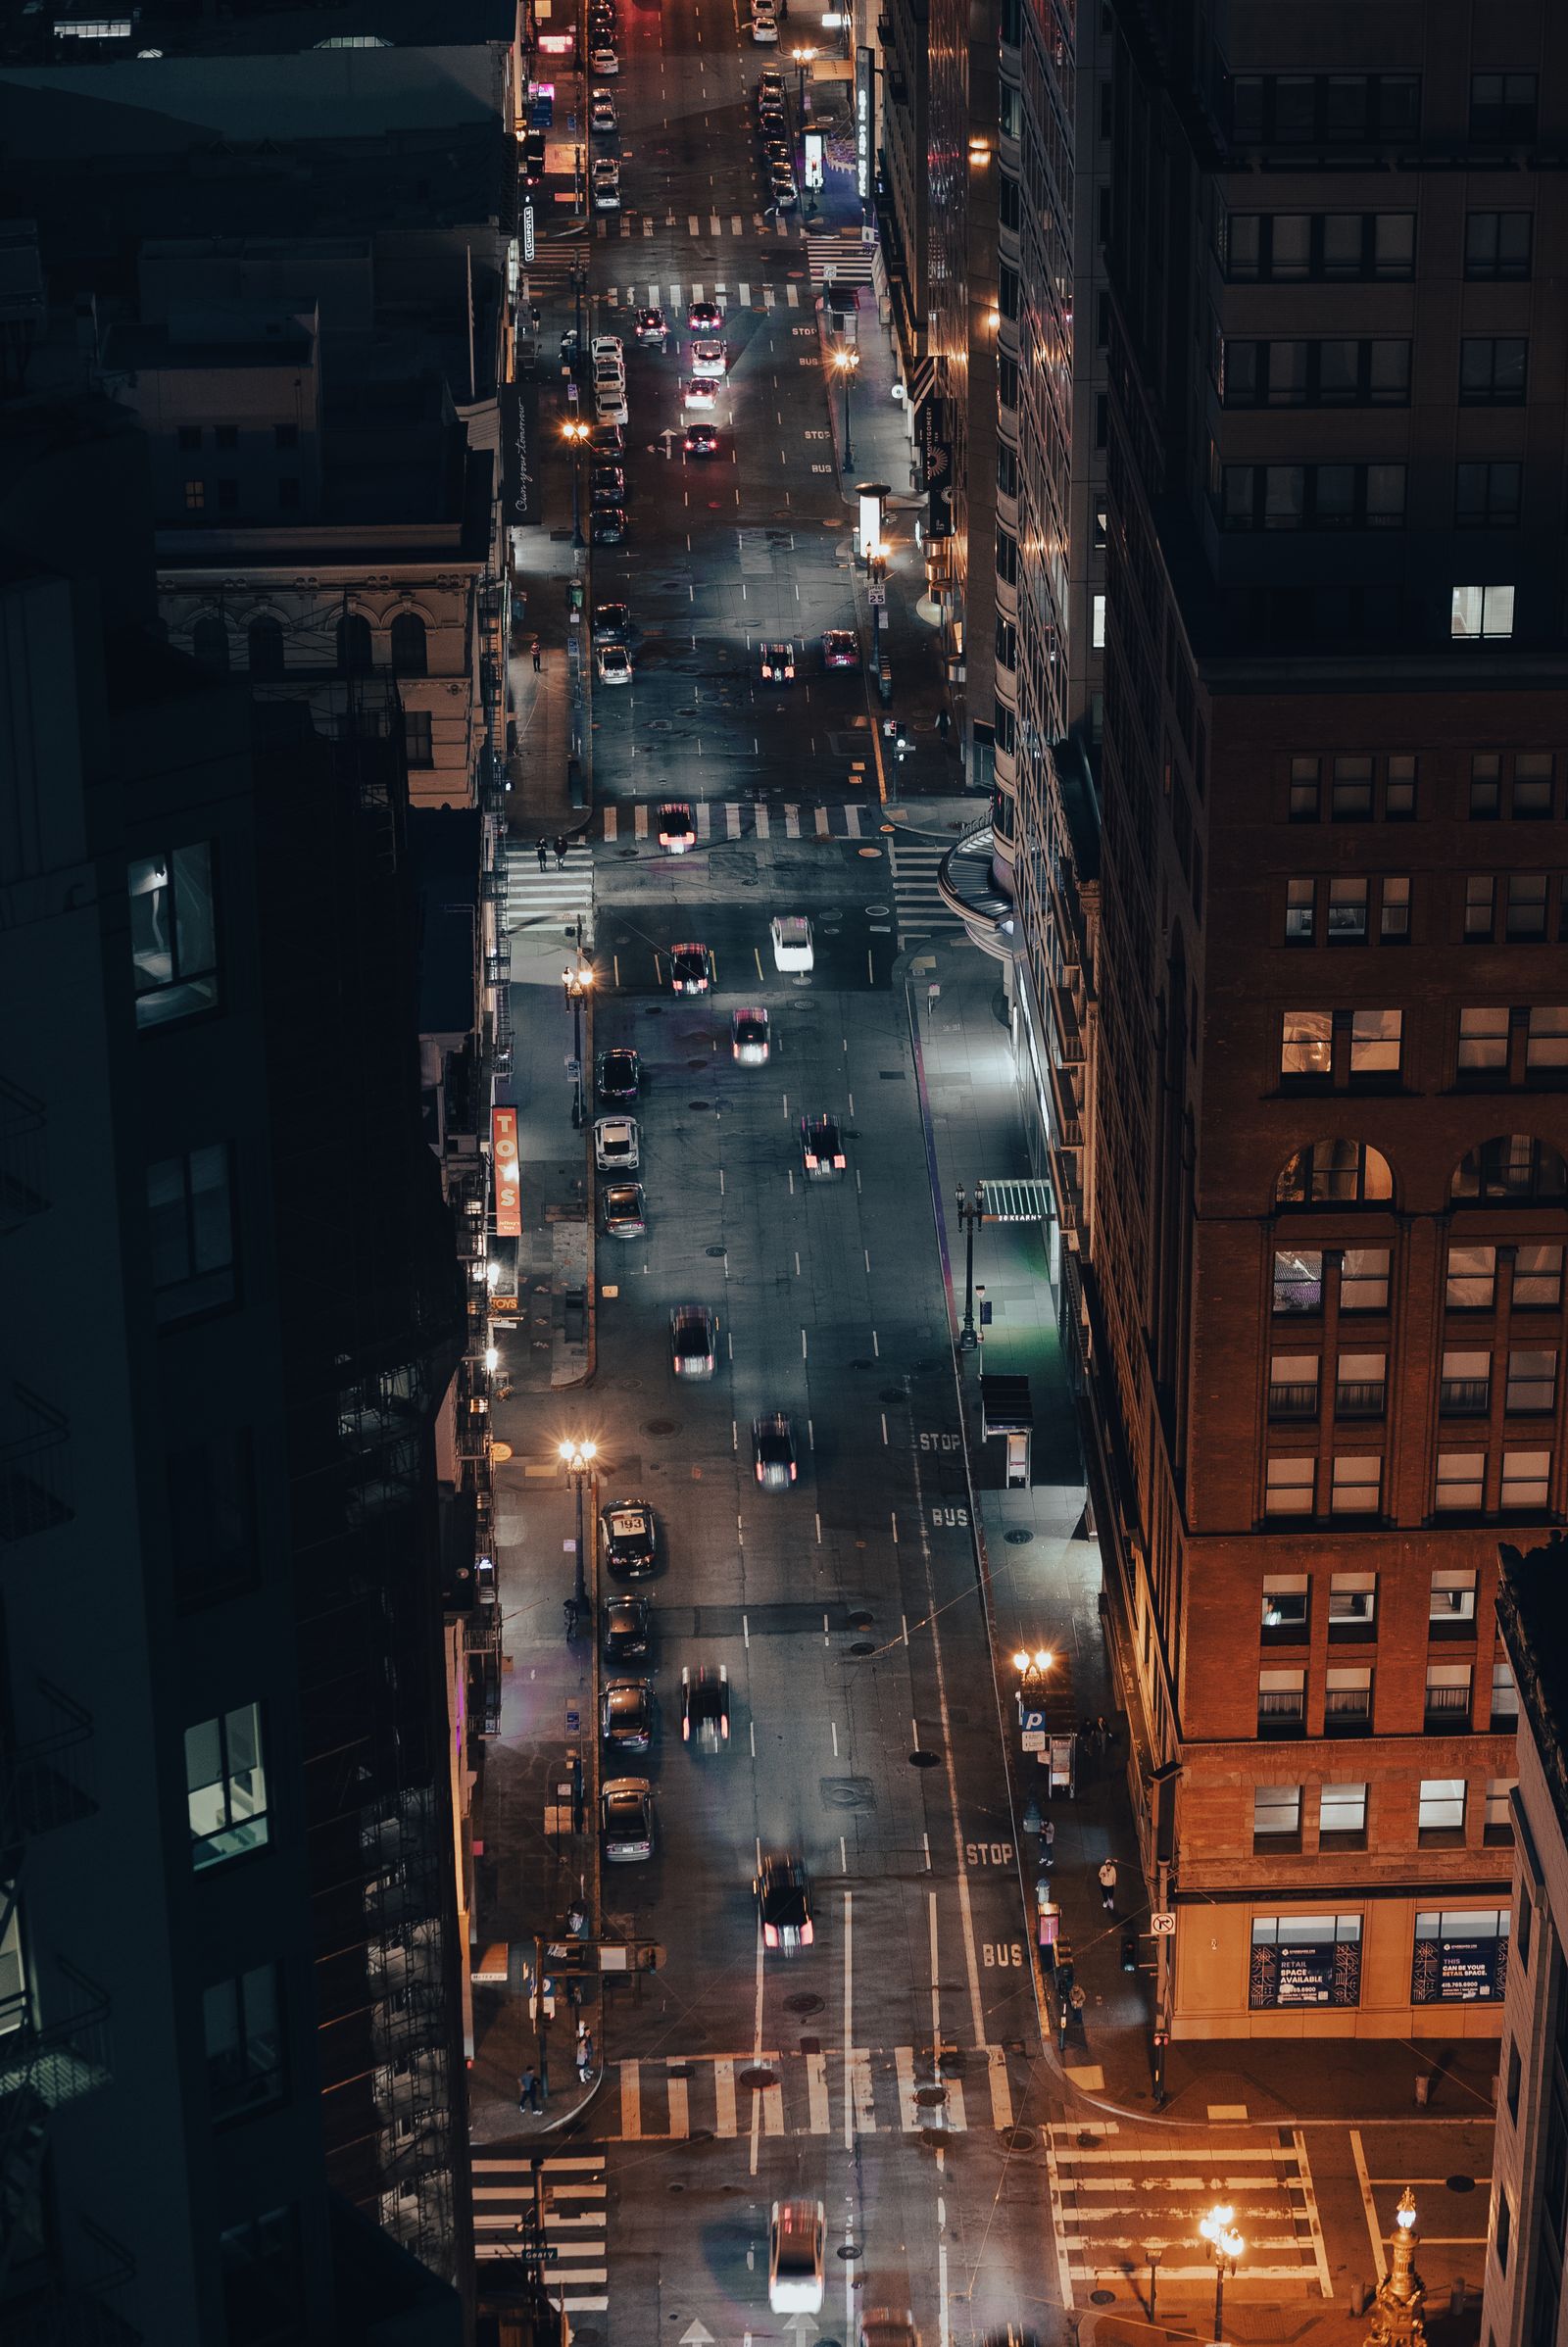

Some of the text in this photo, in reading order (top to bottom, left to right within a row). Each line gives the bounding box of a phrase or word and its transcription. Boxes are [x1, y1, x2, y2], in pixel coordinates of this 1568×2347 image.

[496, 1115, 517, 1207] TOYS
[492, 1298, 517, 1309] TOYS
[919, 1434, 961, 1450] STOP
[620, 1518, 642, 1529] 193
[932, 1509, 968, 1526] BUS
[966, 1843, 1013, 1865] STOP
[983, 1944, 1022, 1967] BUS
[525, 2251, 554, 2260] Geary
